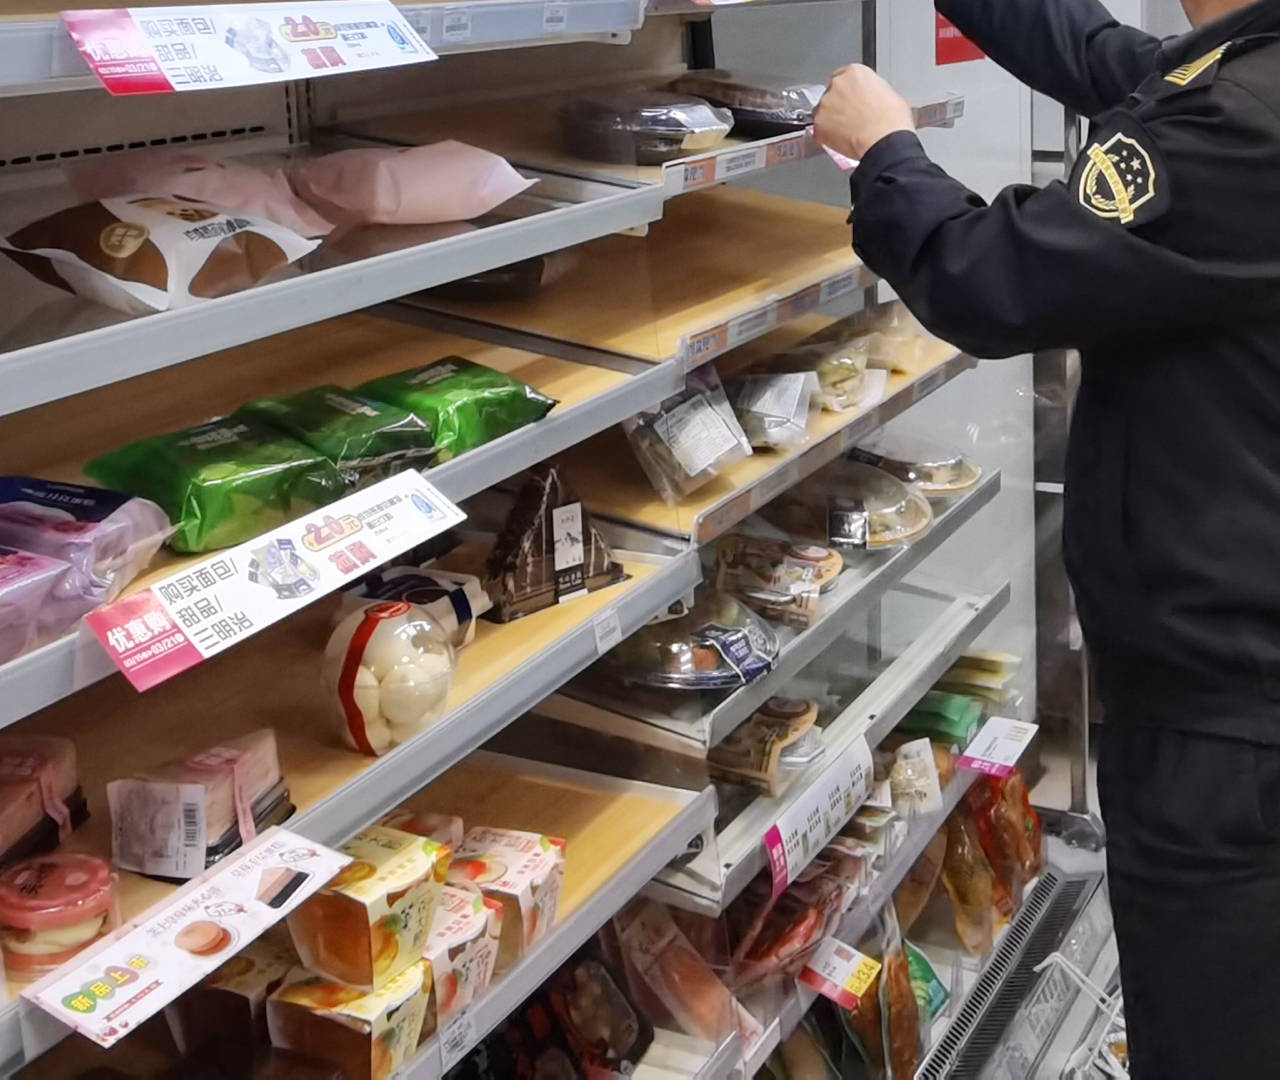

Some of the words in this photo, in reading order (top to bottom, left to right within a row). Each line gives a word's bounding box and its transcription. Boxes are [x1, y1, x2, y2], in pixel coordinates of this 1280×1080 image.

[107, 611, 172, 654] 优惠购
[194, 610, 255, 651] 三明治
